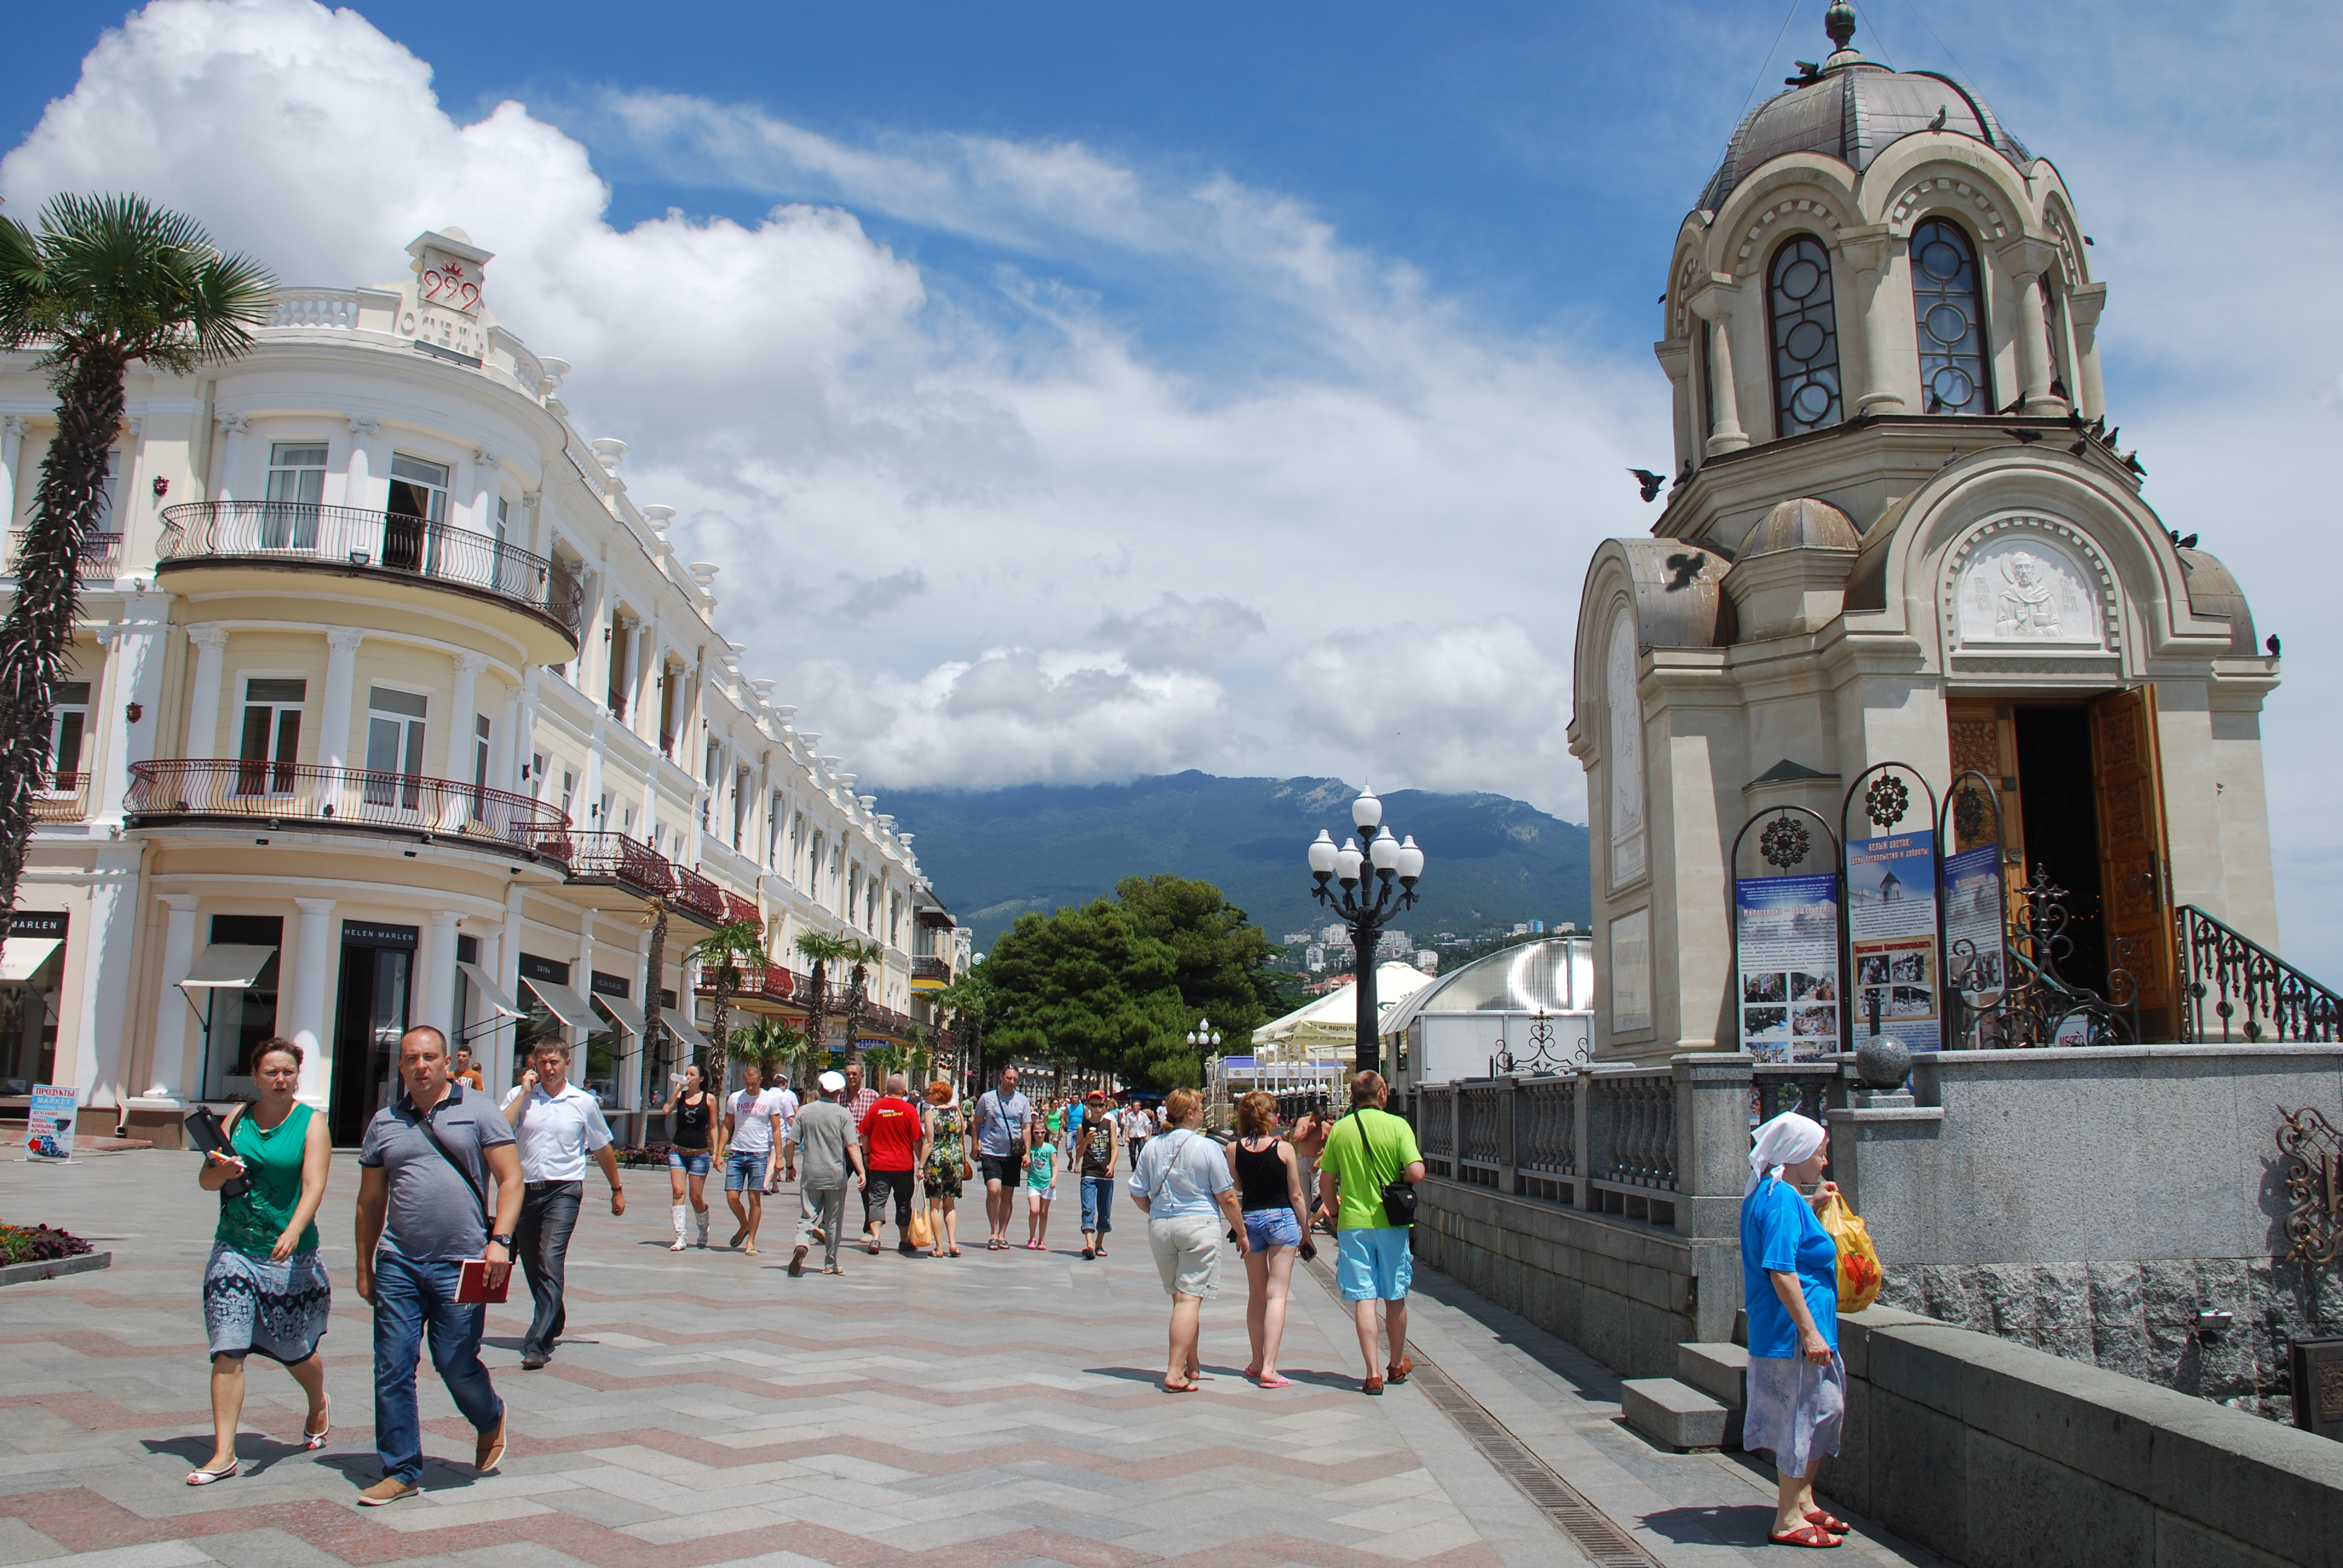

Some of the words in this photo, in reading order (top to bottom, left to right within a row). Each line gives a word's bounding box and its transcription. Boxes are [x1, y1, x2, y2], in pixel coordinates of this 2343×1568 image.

[424, 269, 480, 311] 999
[1906, 847, 1929, 858] доброты
[1743, 908, 1783, 917] Милосердие
[1792, 905, 1812, 915] общее
[1814, 905, 1831, 914] дело
[378, 932, 413, 941] MARLEN
[36, 1088, 74, 1097] ПРОДУКТЫ
[736, 1102, 750, 1112] PASS
